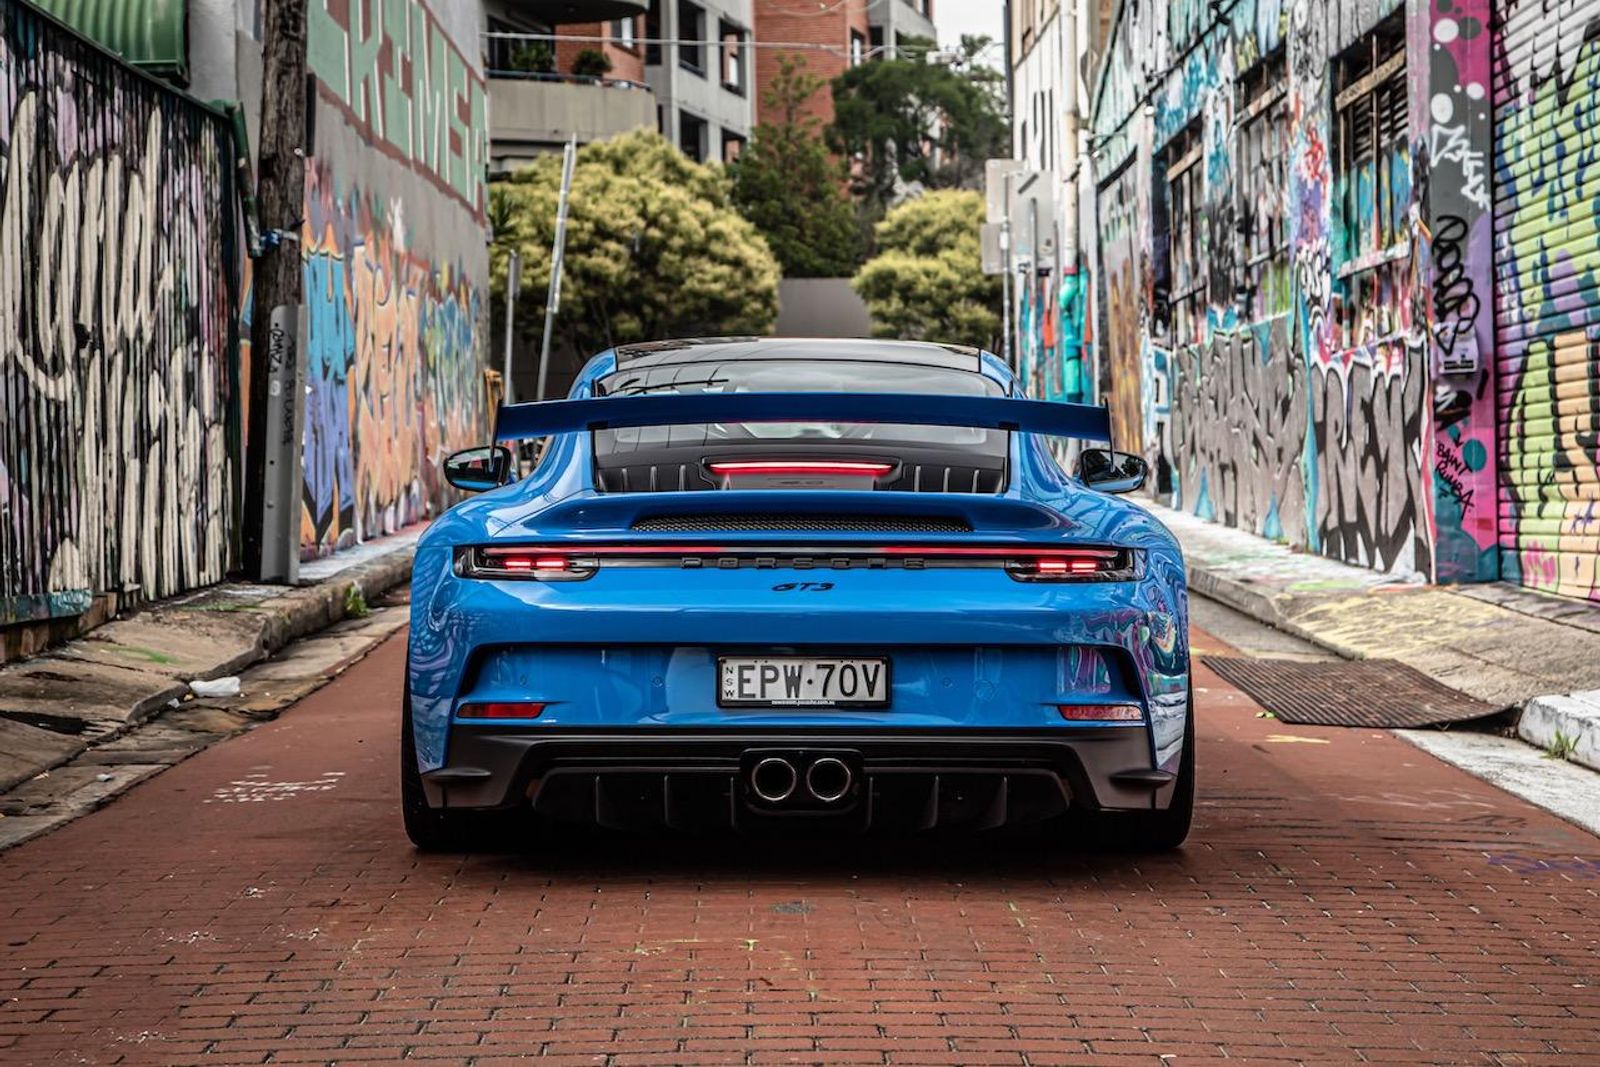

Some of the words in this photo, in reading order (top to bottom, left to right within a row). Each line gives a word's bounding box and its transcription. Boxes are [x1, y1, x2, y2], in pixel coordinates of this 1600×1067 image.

[681, 557, 926, 568] PORSCHE
[771, 582, 835, 592] GT3
[725, 666, 736, 698] NSW
